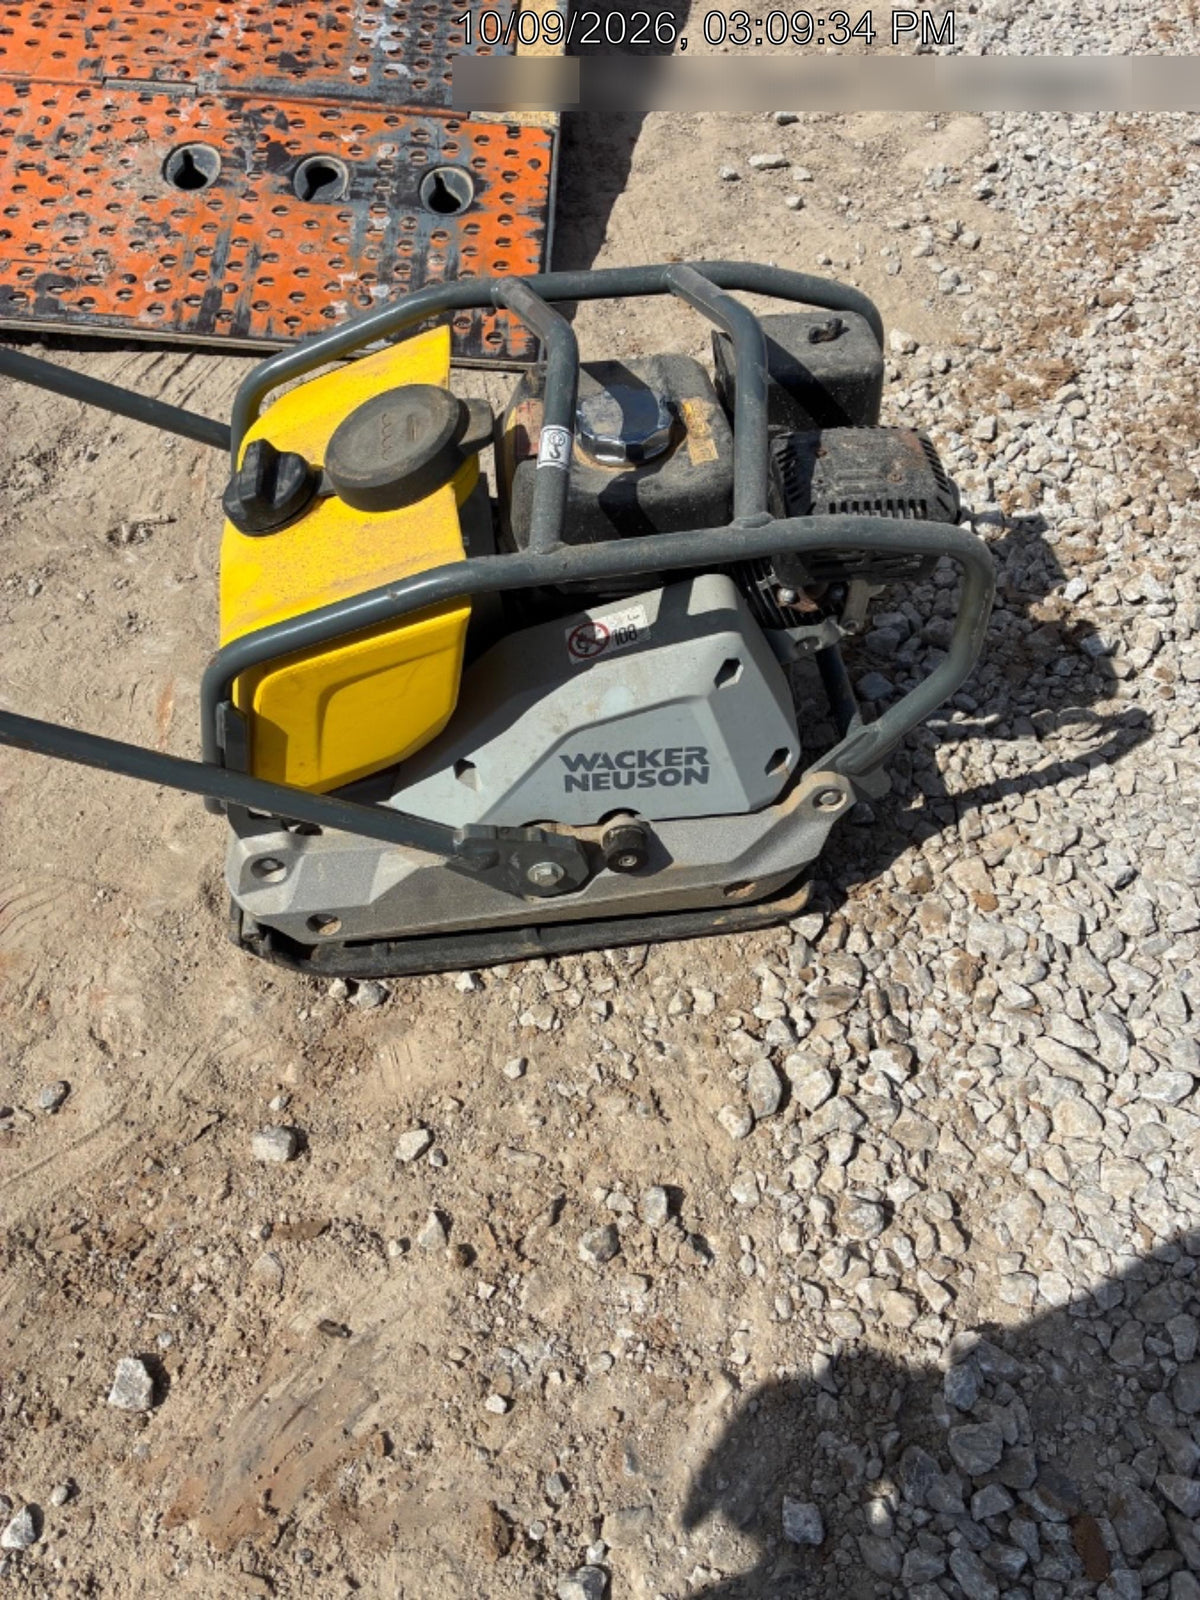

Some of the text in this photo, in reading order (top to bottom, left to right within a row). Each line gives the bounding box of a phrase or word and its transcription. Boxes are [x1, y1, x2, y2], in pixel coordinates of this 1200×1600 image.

[614, 624, 638, 646] 108
[559, 746, 710, 772] WACKER
[564, 765, 710, 793] NEUSON
